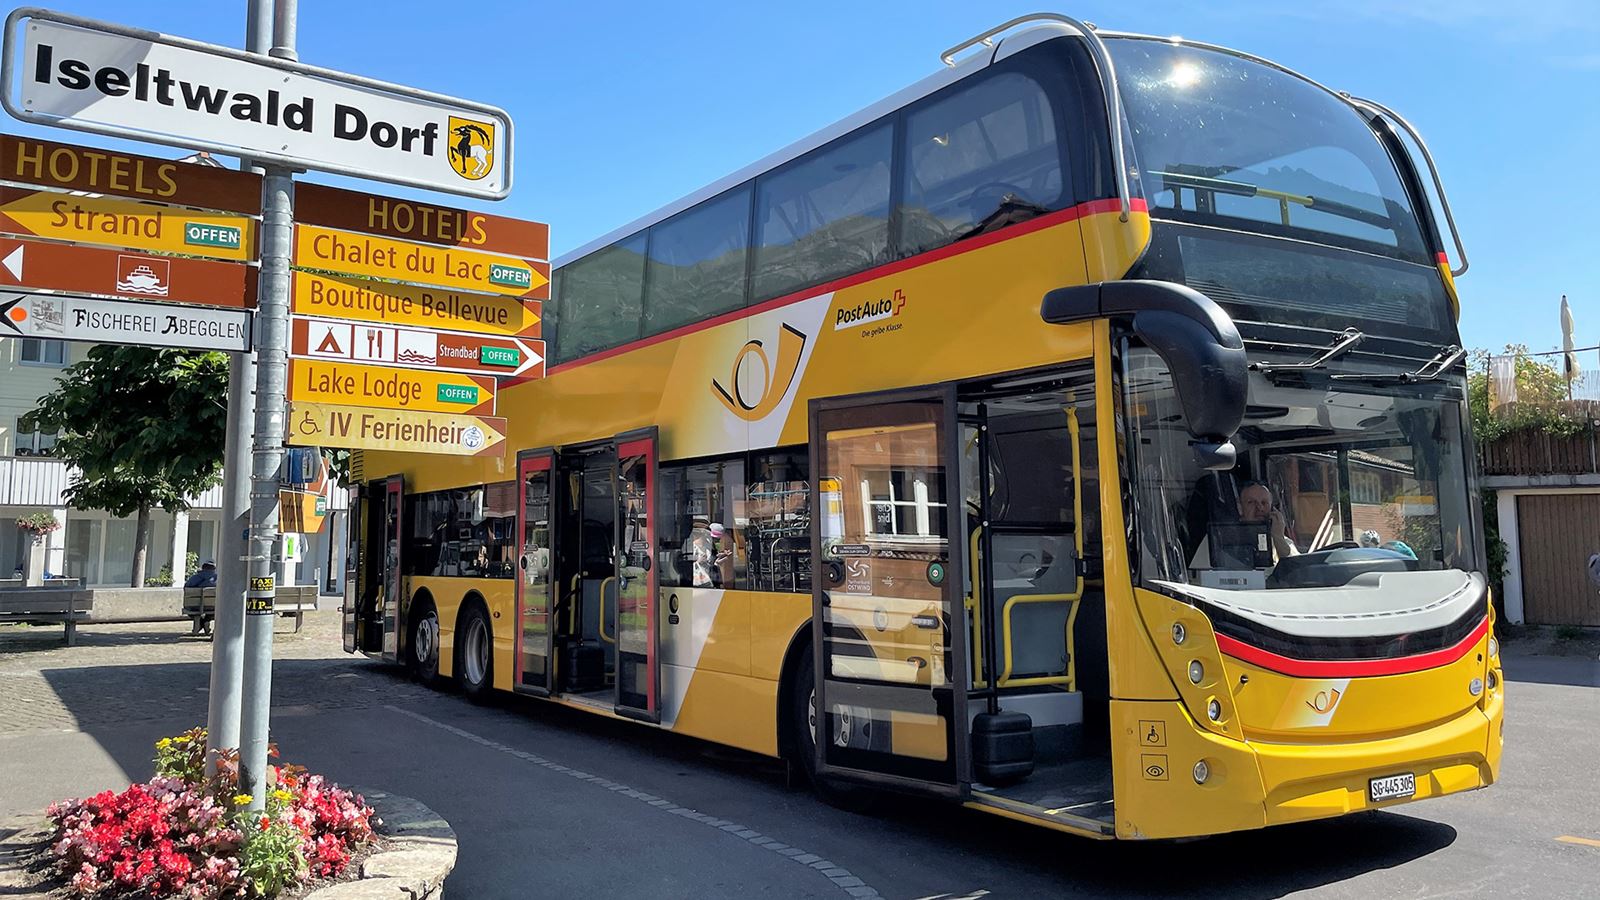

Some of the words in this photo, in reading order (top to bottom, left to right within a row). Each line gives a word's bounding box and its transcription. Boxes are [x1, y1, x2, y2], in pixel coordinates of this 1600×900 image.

[35, 43, 314, 134] Iseltwald
[334, 103, 439, 157] Dorf
[16, 141, 177, 197] HOTELS
[51, 200, 162, 239] Strand
[368, 197, 488, 245] HOTELS
[190, 227, 238, 244] OFFEN
[313, 234, 397, 269] Chalet
[406, 250, 436, 275] du
[446, 253, 483, 281] Lac
[493, 267, 530, 283] OFFEN
[311, 280, 412, 318] Boutique
[422, 294, 508, 325] Bellevue
[837, 299, 892, 325] PostAuto
[73, 308, 157, 333] FISCHEREI
[161, 315, 245, 340] ABEGGLEN
[439, 343, 478, 360] Strandbad
[488, 350, 514, 362] OFFEN
[308, 367, 355, 395] Lake
[364, 372, 422, 406] Lodge
[445, 388, 473, 400] OFFEN
[330, 411, 352, 438] IV
[251, 577, 273, 585] TAXI
